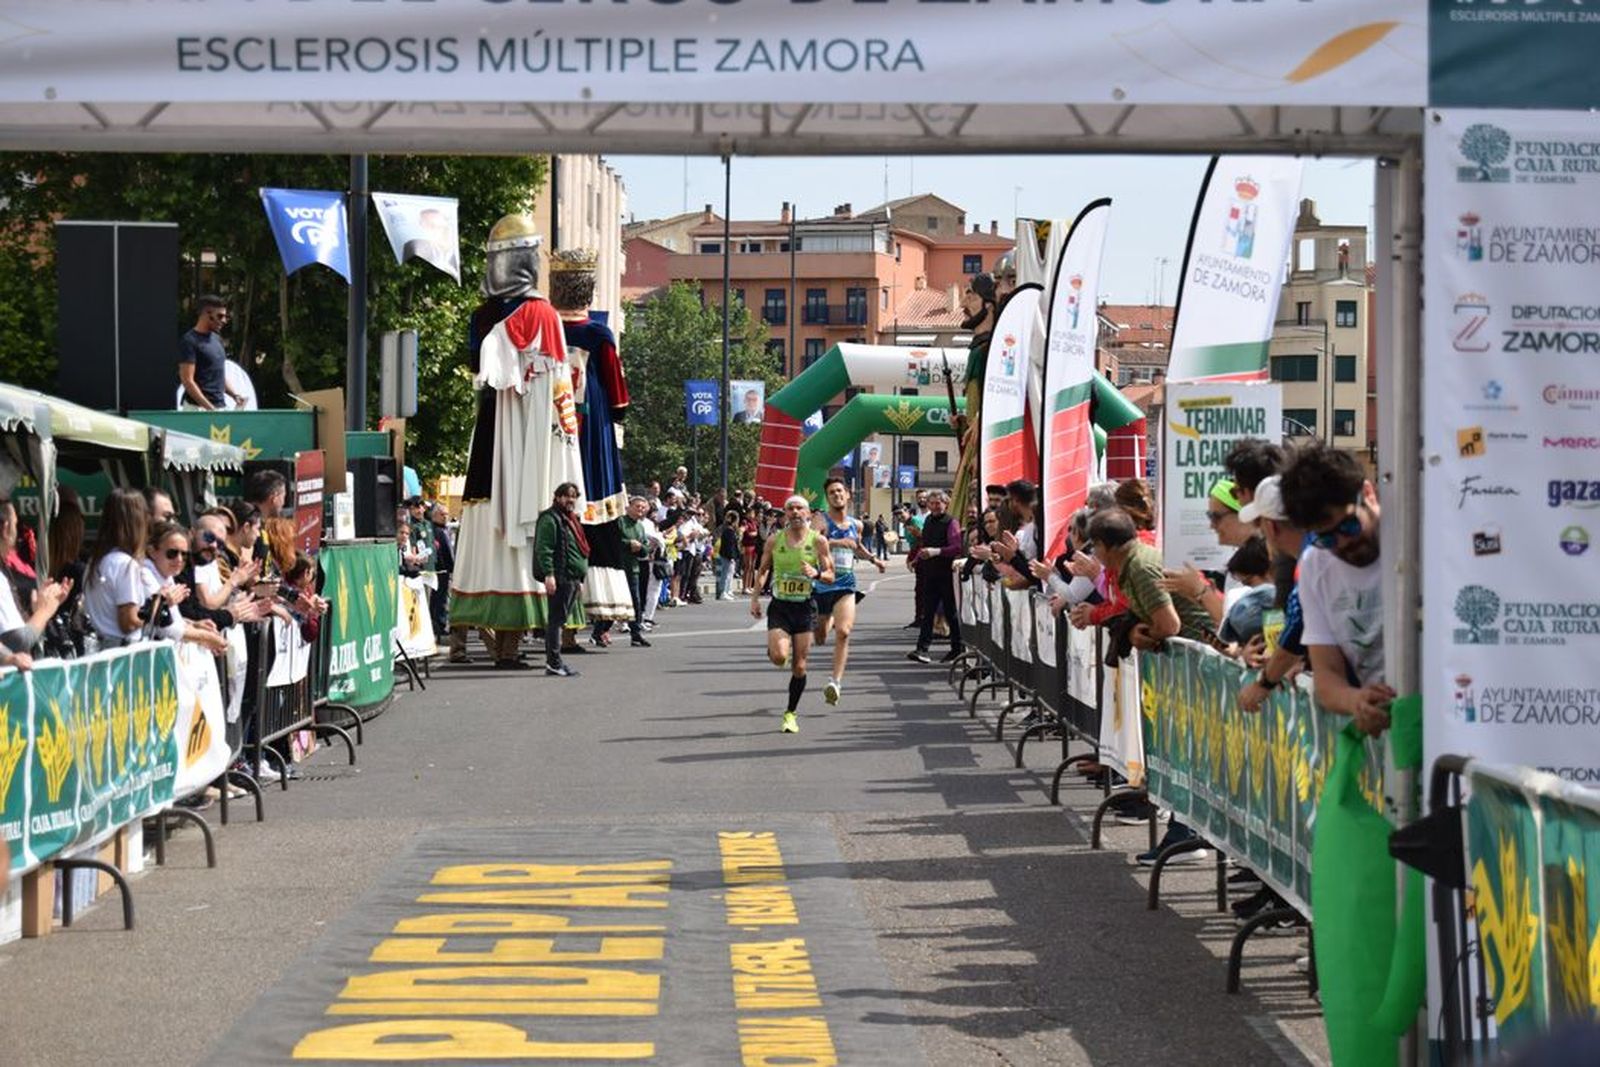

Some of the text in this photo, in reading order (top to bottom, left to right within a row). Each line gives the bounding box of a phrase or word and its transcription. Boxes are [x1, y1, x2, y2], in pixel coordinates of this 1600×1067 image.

[1450, 9, 1519, 22] ESCLEROSIS
[176, 30, 926, 73] ESCLEROSIS MÚLTIPLE ZAMORA
[1514, 158, 1555, 172] CAJA
[1489, 242, 1517, 263] DE
[1193, 266, 1267, 304] DE ZAMORA
[1184, 407, 1267, 435] TERMINAR
[1176, 440, 1196, 467] LA
[1184, 472, 1206, 499] EN
[783, 582, 804, 593] 104
[1503, 621, 1545, 634] CAJA
[1505, 636, 1566, 646] DE ZAMORA
[1480, 703, 1506, 724] DE
[291, 859, 675, 1061] PIDEPAR
